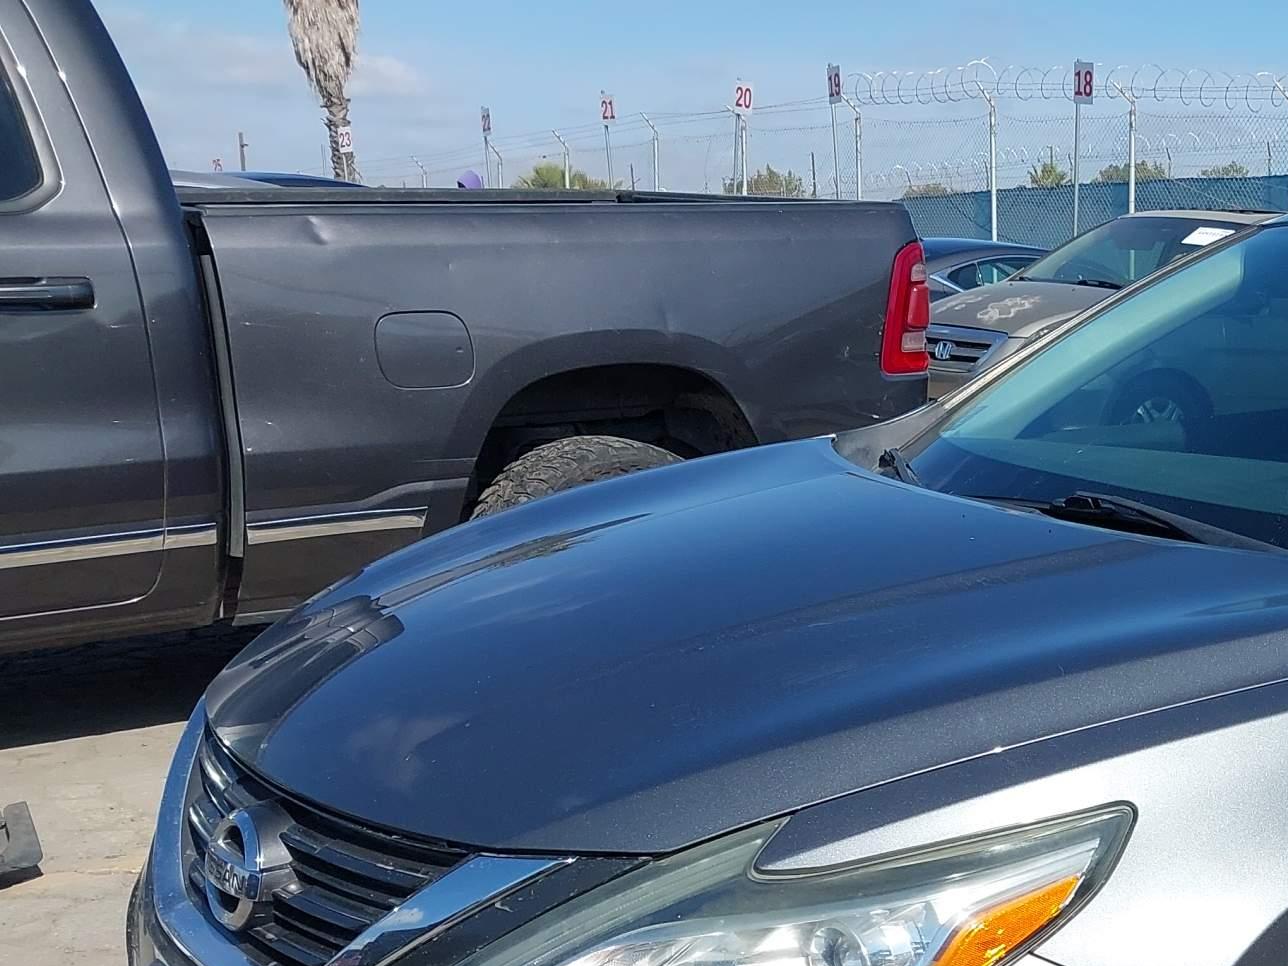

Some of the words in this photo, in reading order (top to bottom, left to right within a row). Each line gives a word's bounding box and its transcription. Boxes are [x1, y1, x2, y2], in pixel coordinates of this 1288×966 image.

[829, 73, 841, 98] 19
[1074, 70, 1093, 97] 18
[735, 86, 752, 109] 20
[601, 99, 615, 120] 21
[481, 113, 491, 132] 22
[339, 131, 351, 148] 23
